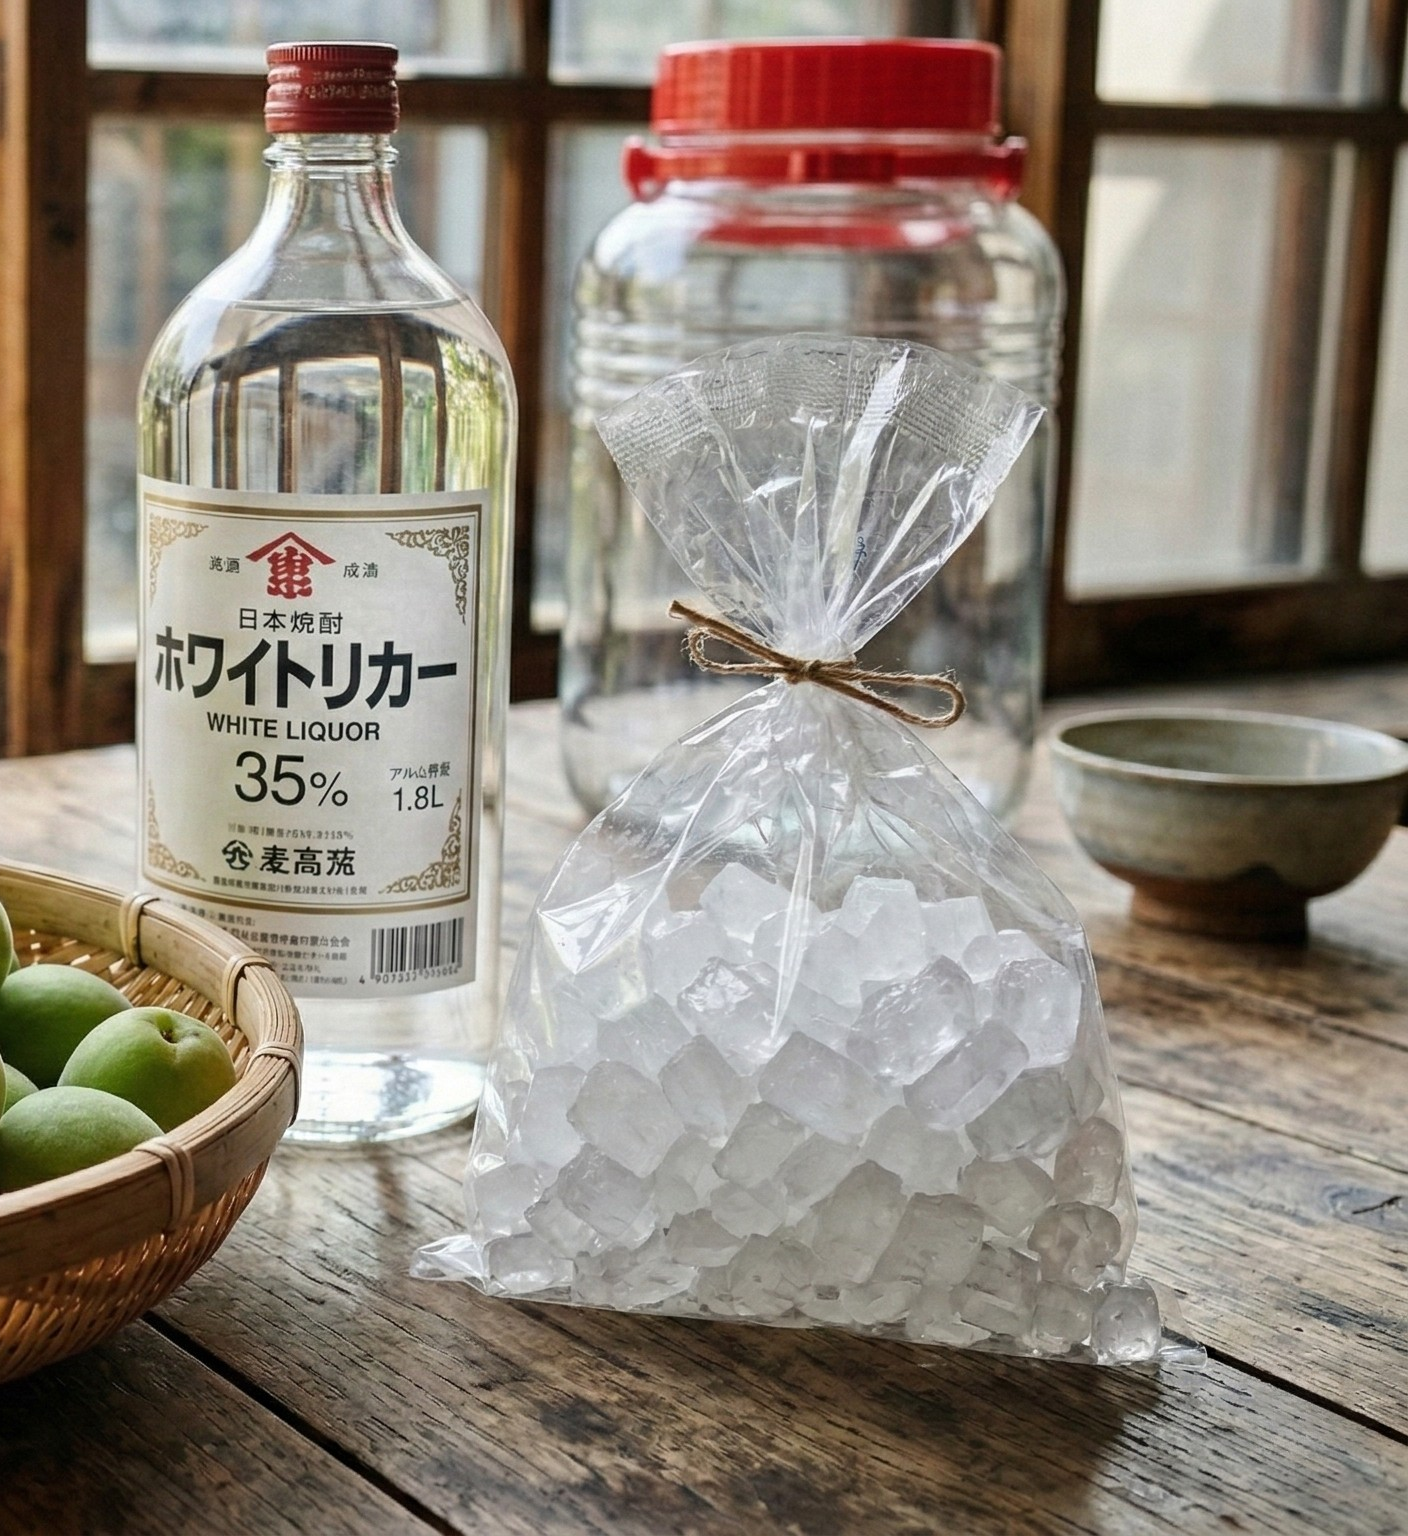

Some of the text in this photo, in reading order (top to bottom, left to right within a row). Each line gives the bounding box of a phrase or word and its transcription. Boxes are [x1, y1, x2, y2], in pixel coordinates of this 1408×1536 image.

[239, 608, 343, 635] 日本焼酎
[155, 625, 458, 710] ホワイトリカー
[207, 712, 381, 742] WHITE LIQUOR
[234, 751, 348, 807] 35%
[393, 785, 444, 812] 1.8L
